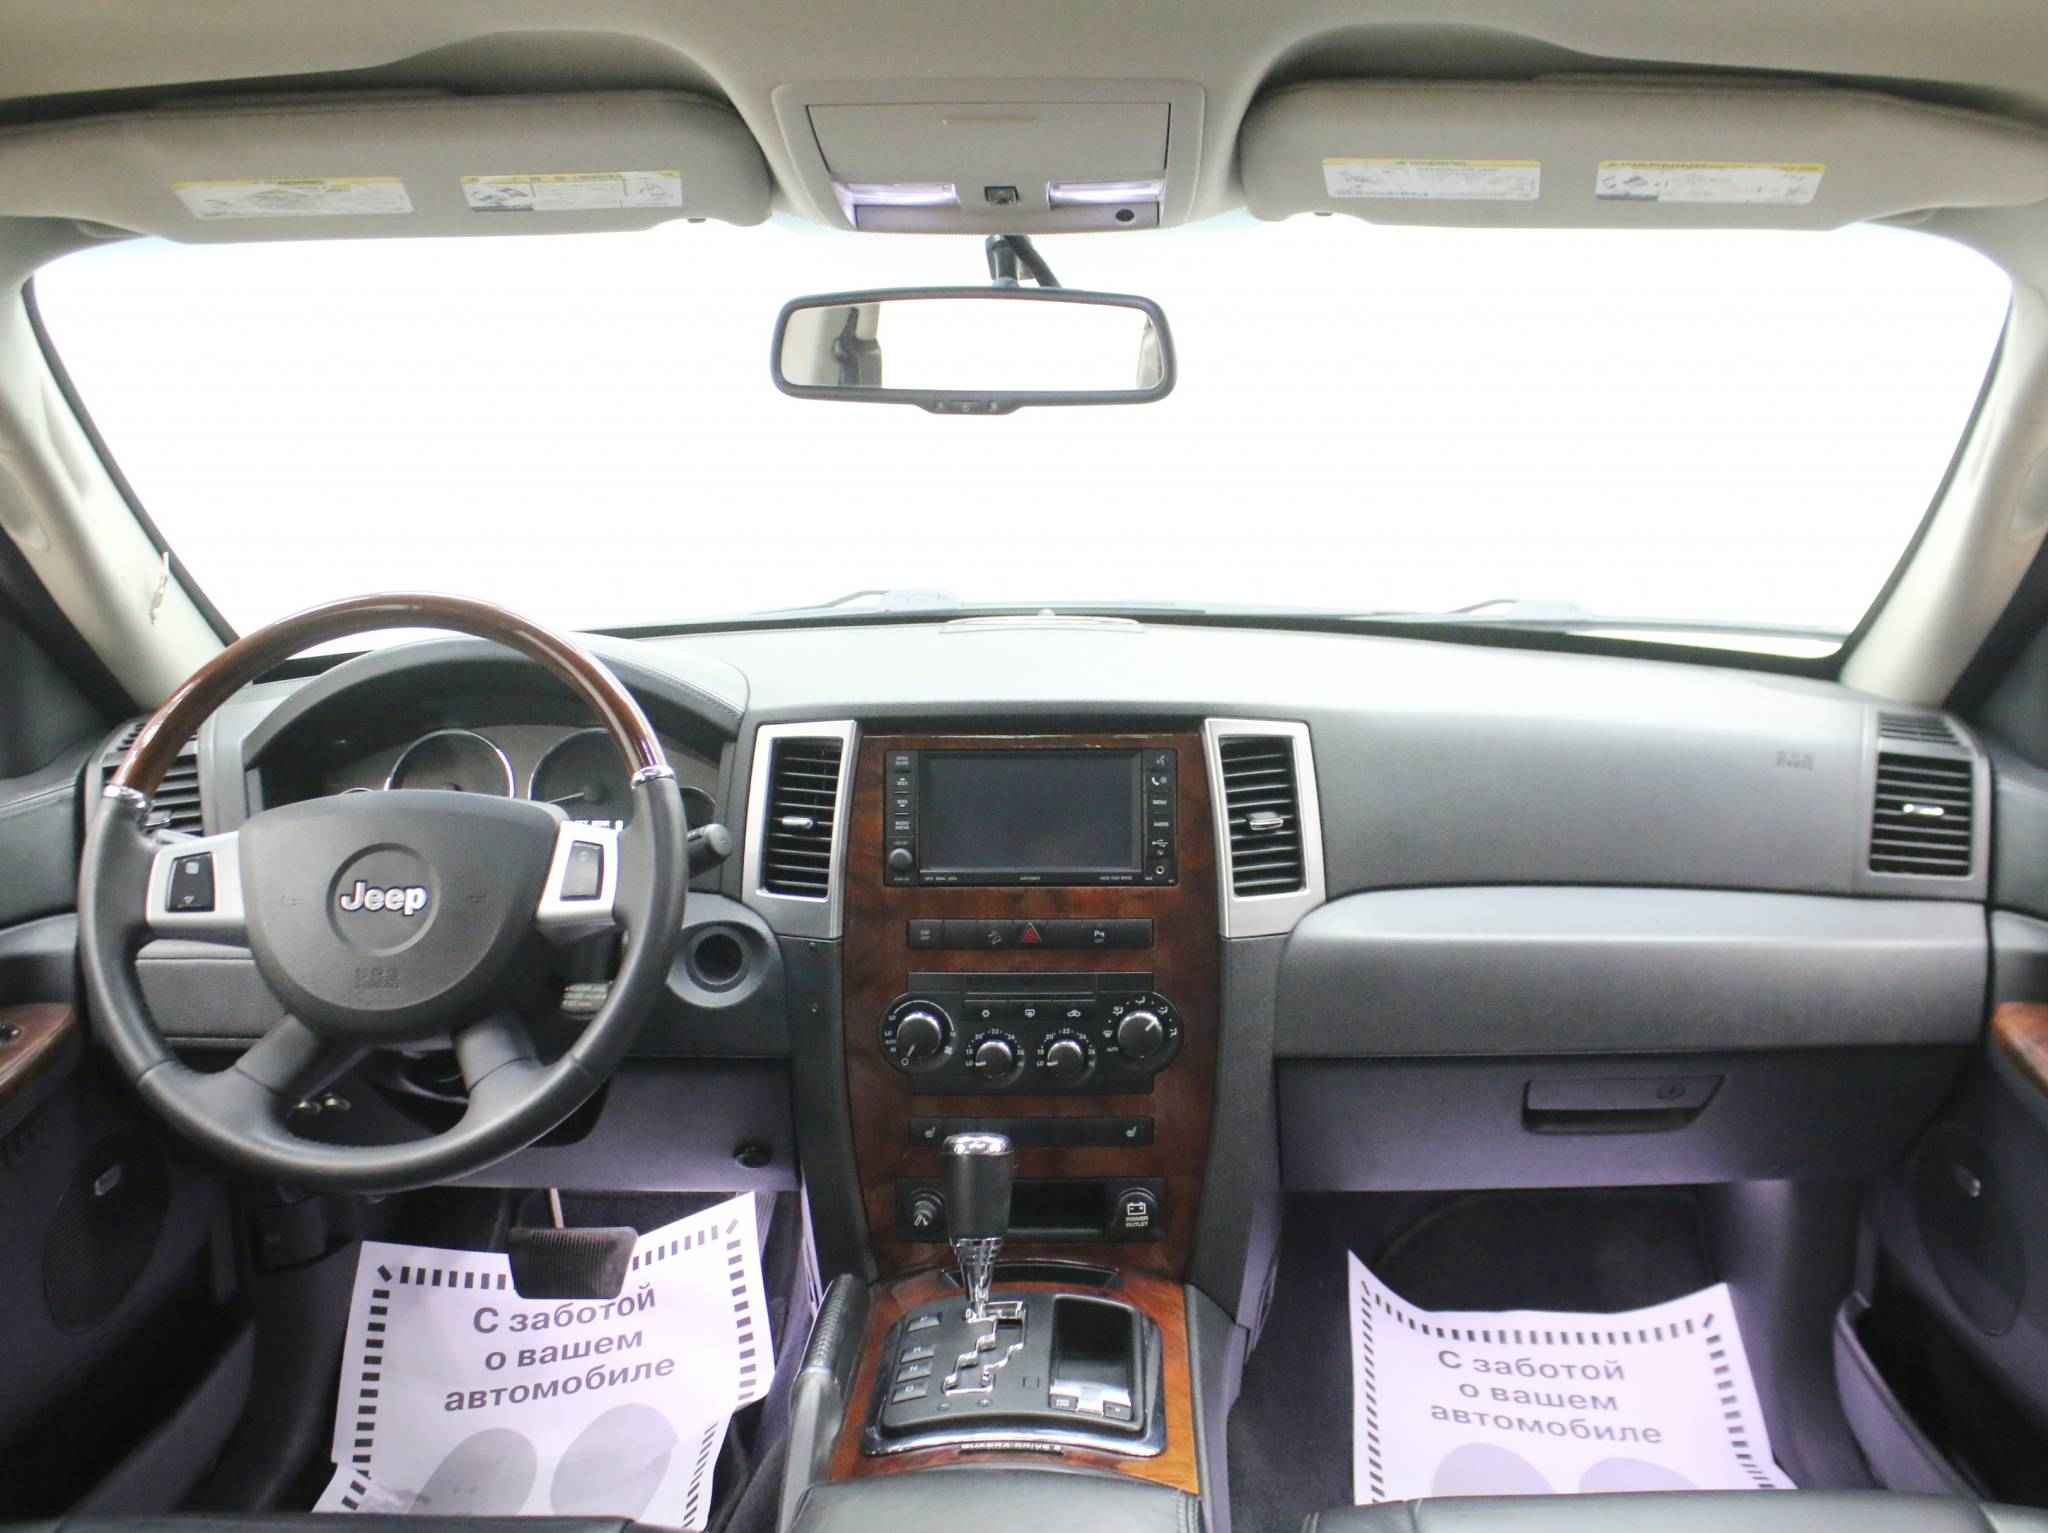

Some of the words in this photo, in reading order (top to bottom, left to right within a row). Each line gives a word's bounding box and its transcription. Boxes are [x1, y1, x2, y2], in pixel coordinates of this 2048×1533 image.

[340, 880, 428, 916] Jeep
[509, 1282, 656, 1332] заботой
[485, 1351, 507, 1371] о
[516, 1330, 643, 1367] вашем
[1472, 1357, 1625, 1380] заботой
[444, 1357, 676, 1412] автомобиле
[1458, 1383, 1479, 1398] о
[1490, 1386, 1619, 1411] вашем
[1431, 1404, 1663, 1444] автомобиле
